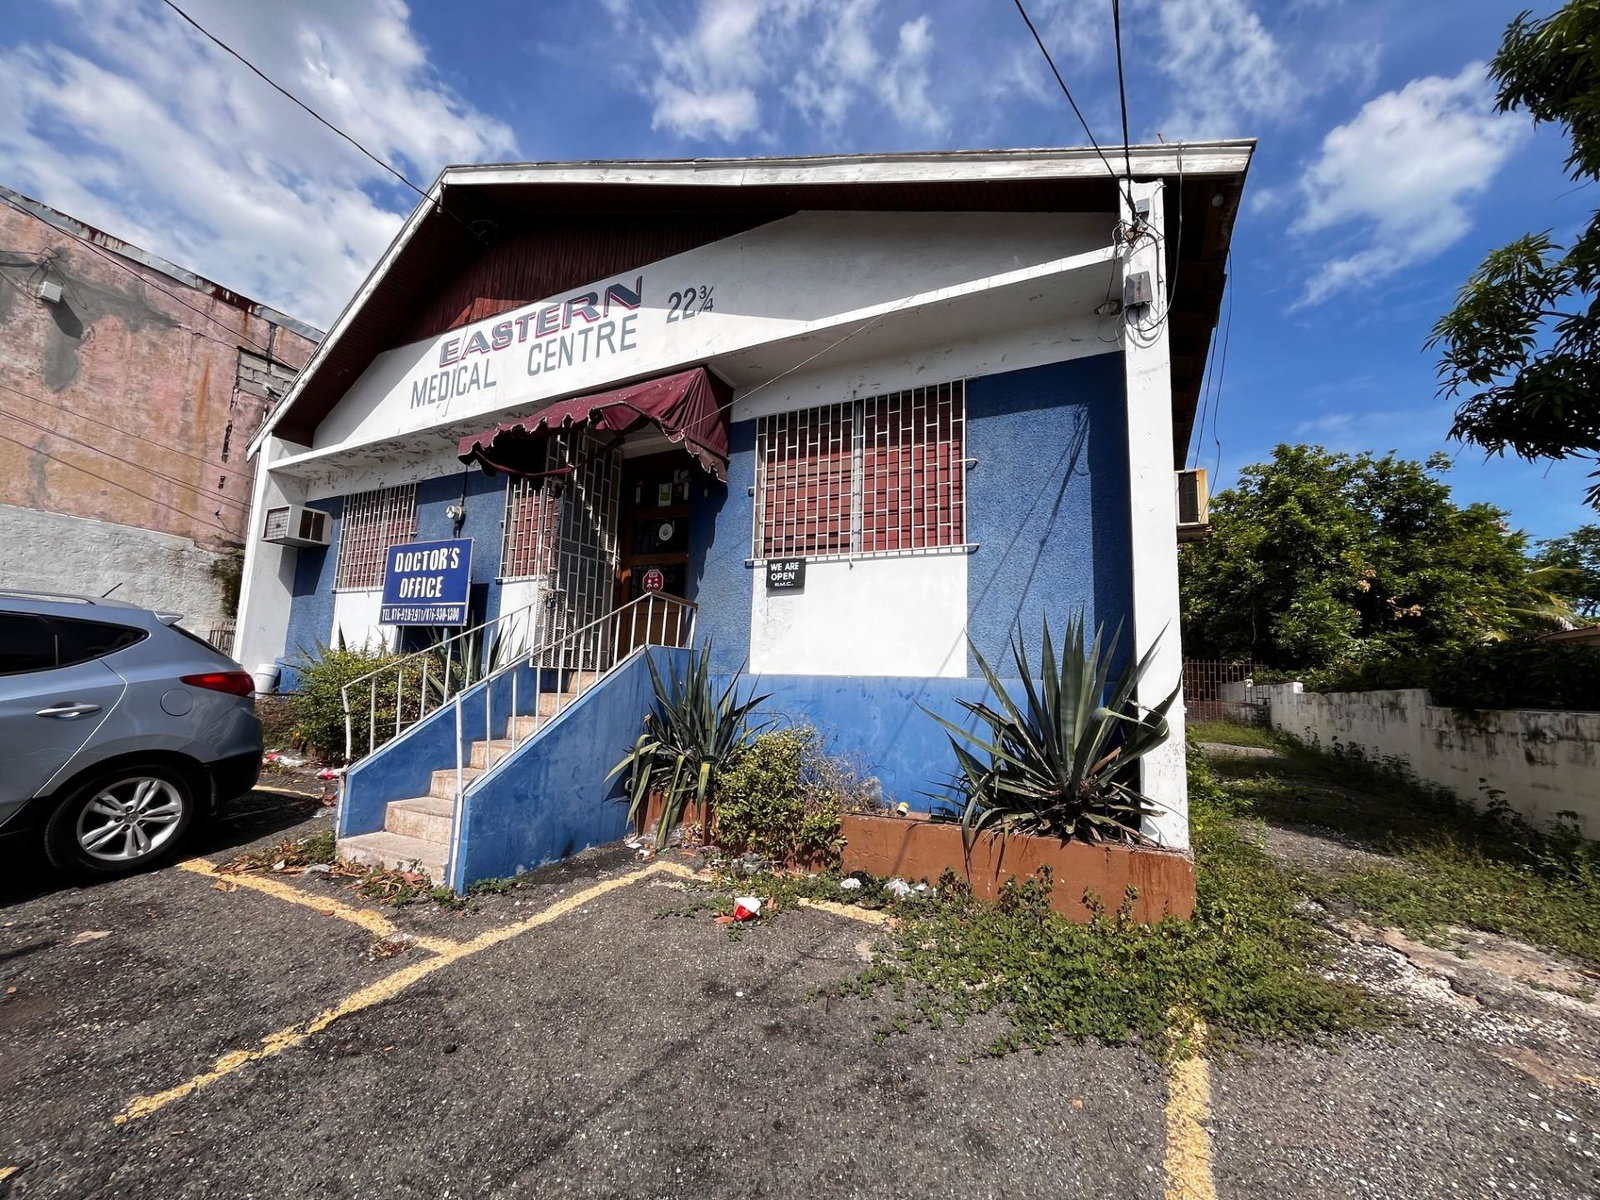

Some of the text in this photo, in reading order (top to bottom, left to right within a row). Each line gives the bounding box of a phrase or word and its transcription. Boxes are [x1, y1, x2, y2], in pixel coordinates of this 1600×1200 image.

[439, 275, 643, 368] EASTERN
[410, 313, 639, 409] MEDICAL CENTRE
[394, 547, 460, 573] DOCTOR'S
[770, 562, 799, 571] WE ARE
[399, 576, 444, 599] OFFICE
[770, 571, 795, 581] OPEN
